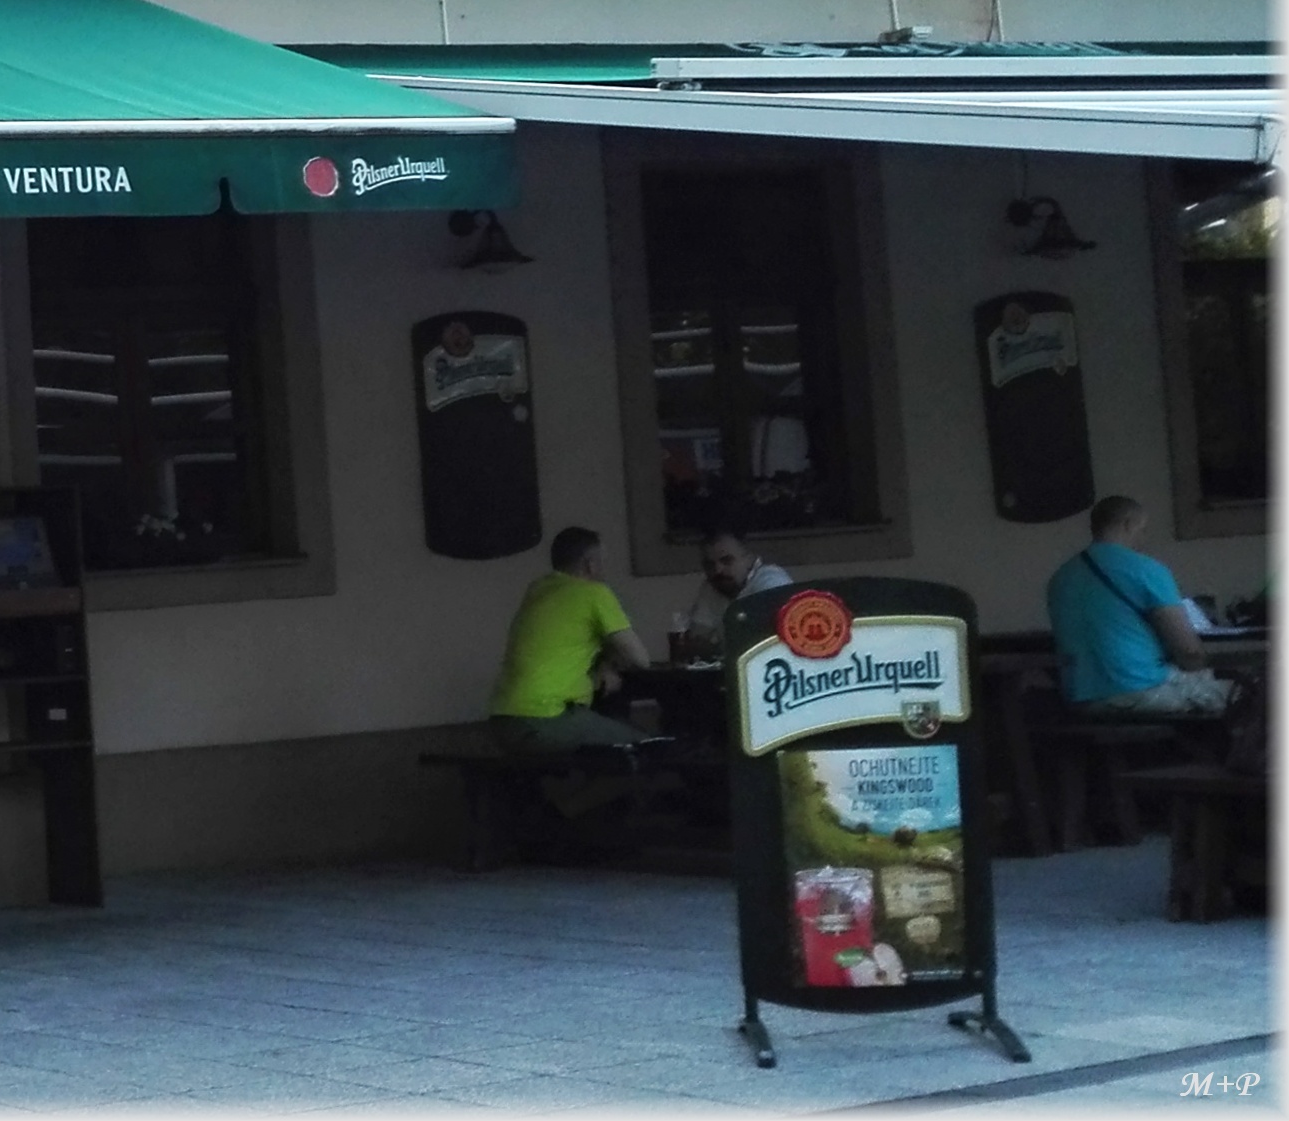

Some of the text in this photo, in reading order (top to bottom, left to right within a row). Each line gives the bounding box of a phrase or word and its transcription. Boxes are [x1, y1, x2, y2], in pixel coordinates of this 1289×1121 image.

[2, 166, 132, 195] VENTURA
[351, 156, 446, 196] Pilsner Urquell
[763, 650, 942, 719] Pilsner Urquell
[849, 755, 940, 778] OCHUTNEJTE
[857, 777, 934, 795] KINGSWOOD
